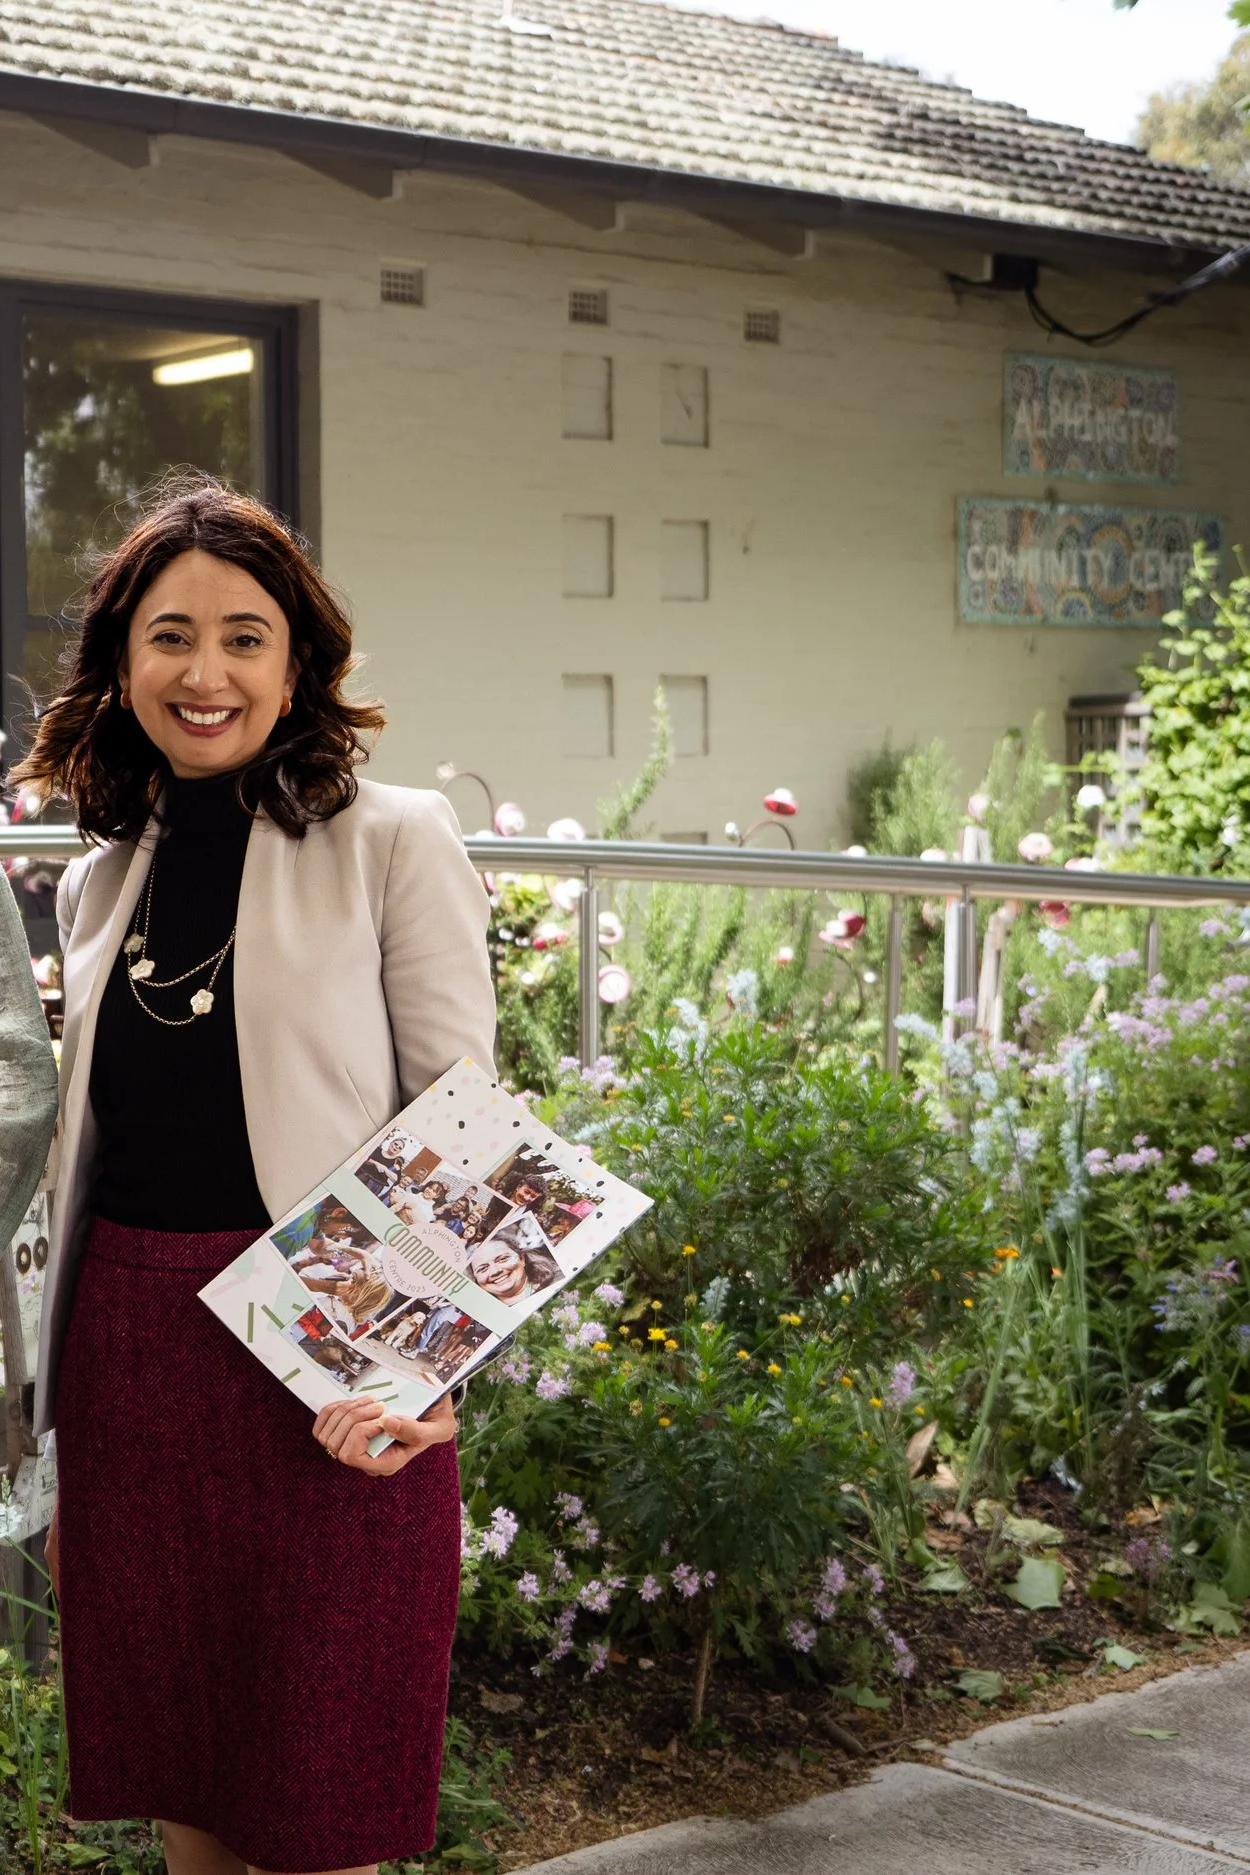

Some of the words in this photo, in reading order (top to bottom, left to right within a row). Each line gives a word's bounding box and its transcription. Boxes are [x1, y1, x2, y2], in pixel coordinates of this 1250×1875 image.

[384, 1223, 470, 1296] COMMUNITY
[421, 1228, 462, 1263] ALPHINGTON
[389, 1259, 406, 1287] CENTRE
